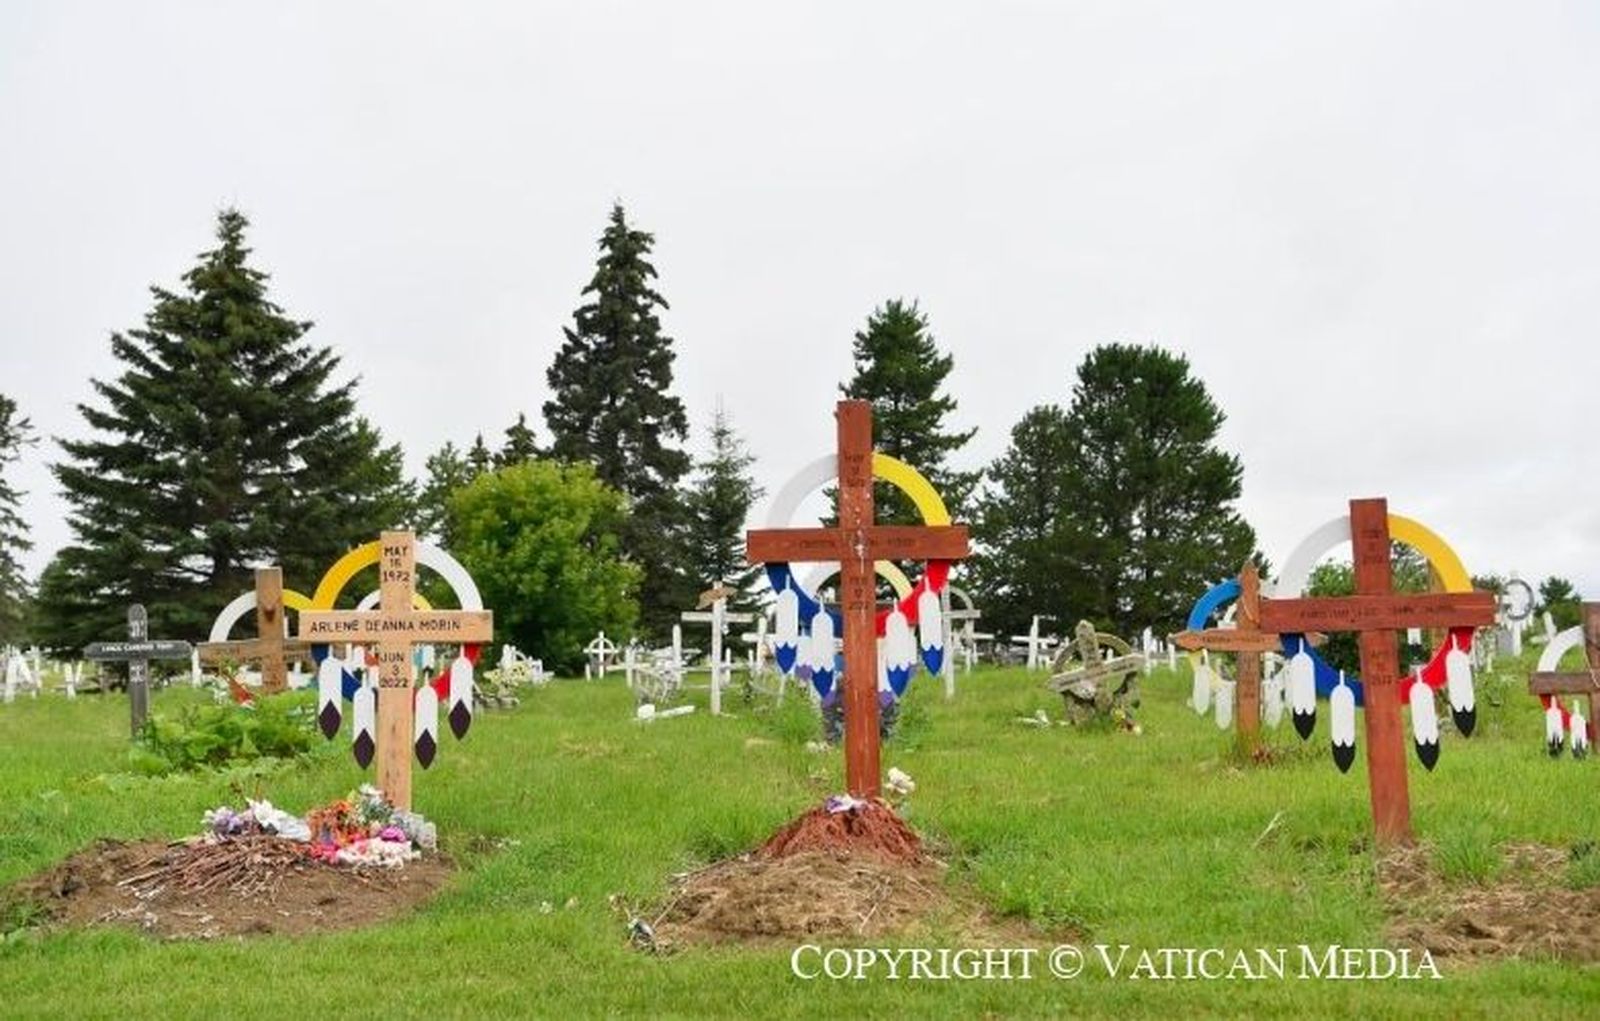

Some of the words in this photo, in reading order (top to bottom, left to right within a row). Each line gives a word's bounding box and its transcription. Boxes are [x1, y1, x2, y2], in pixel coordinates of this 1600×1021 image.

[384, 546, 408, 557] MAY
[383, 570, 410, 582] 1972
[310, 620, 359, 633] ARLENE
[365, 620, 414, 632] DEANNA
[419, 619, 461, 631] MORIN
[380, 651, 405, 663] JUN
[392, 664, 400, 676] 3
[379, 676, 409, 688] 2022
